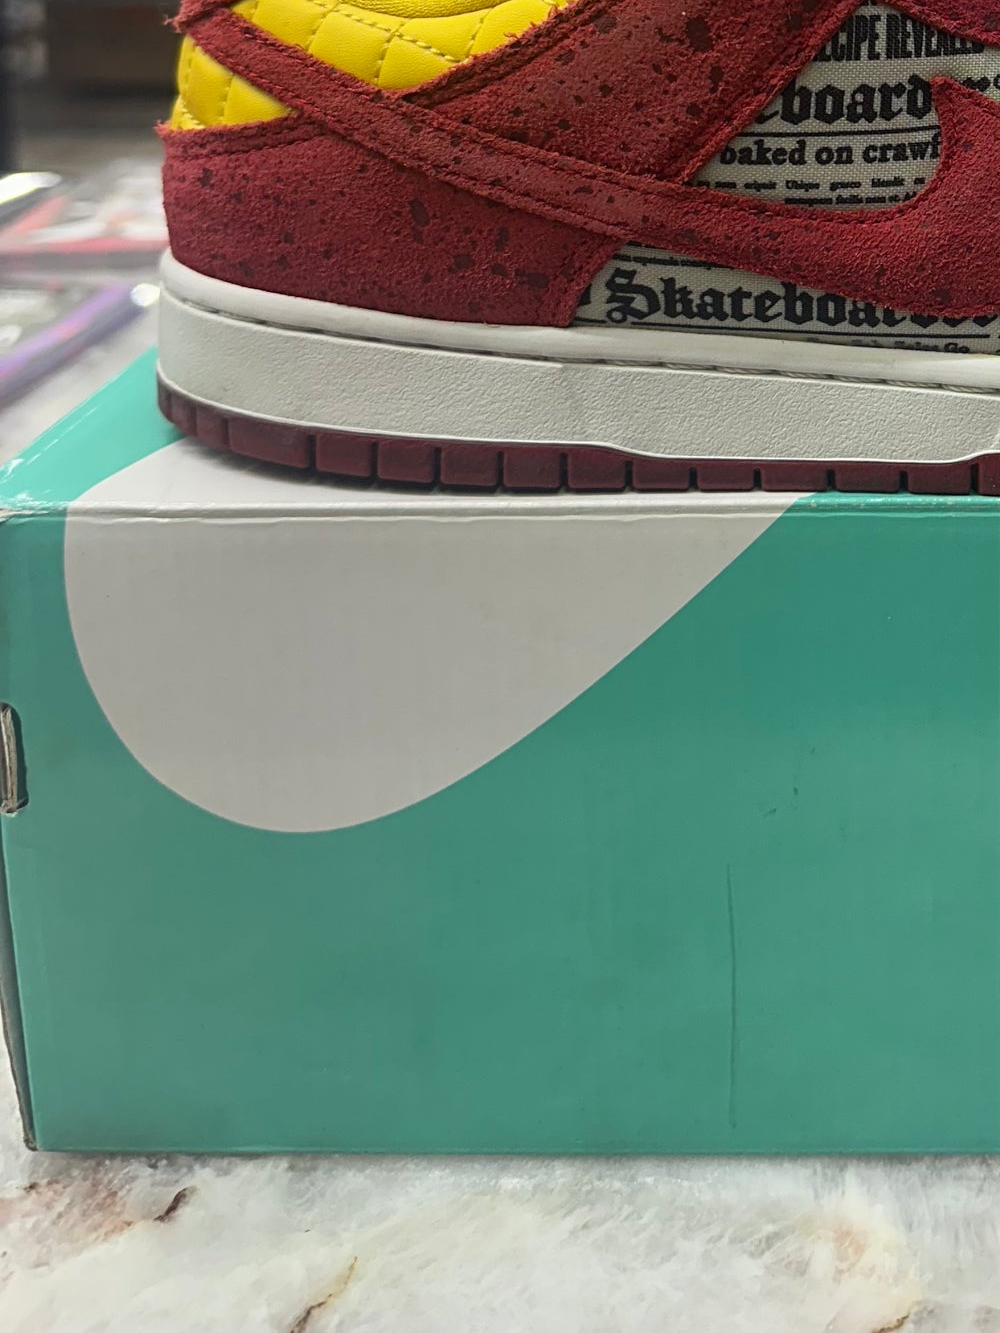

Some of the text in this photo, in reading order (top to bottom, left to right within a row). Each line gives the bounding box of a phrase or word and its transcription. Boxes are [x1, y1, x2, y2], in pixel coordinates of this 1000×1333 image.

[812, 15, 881, 62] CIPE
[754, 73, 991, 126] board
[720, 139, 807, 165] baked
[815, 146, 853, 165] on
[606, 267, 999, 330] Skateboa
